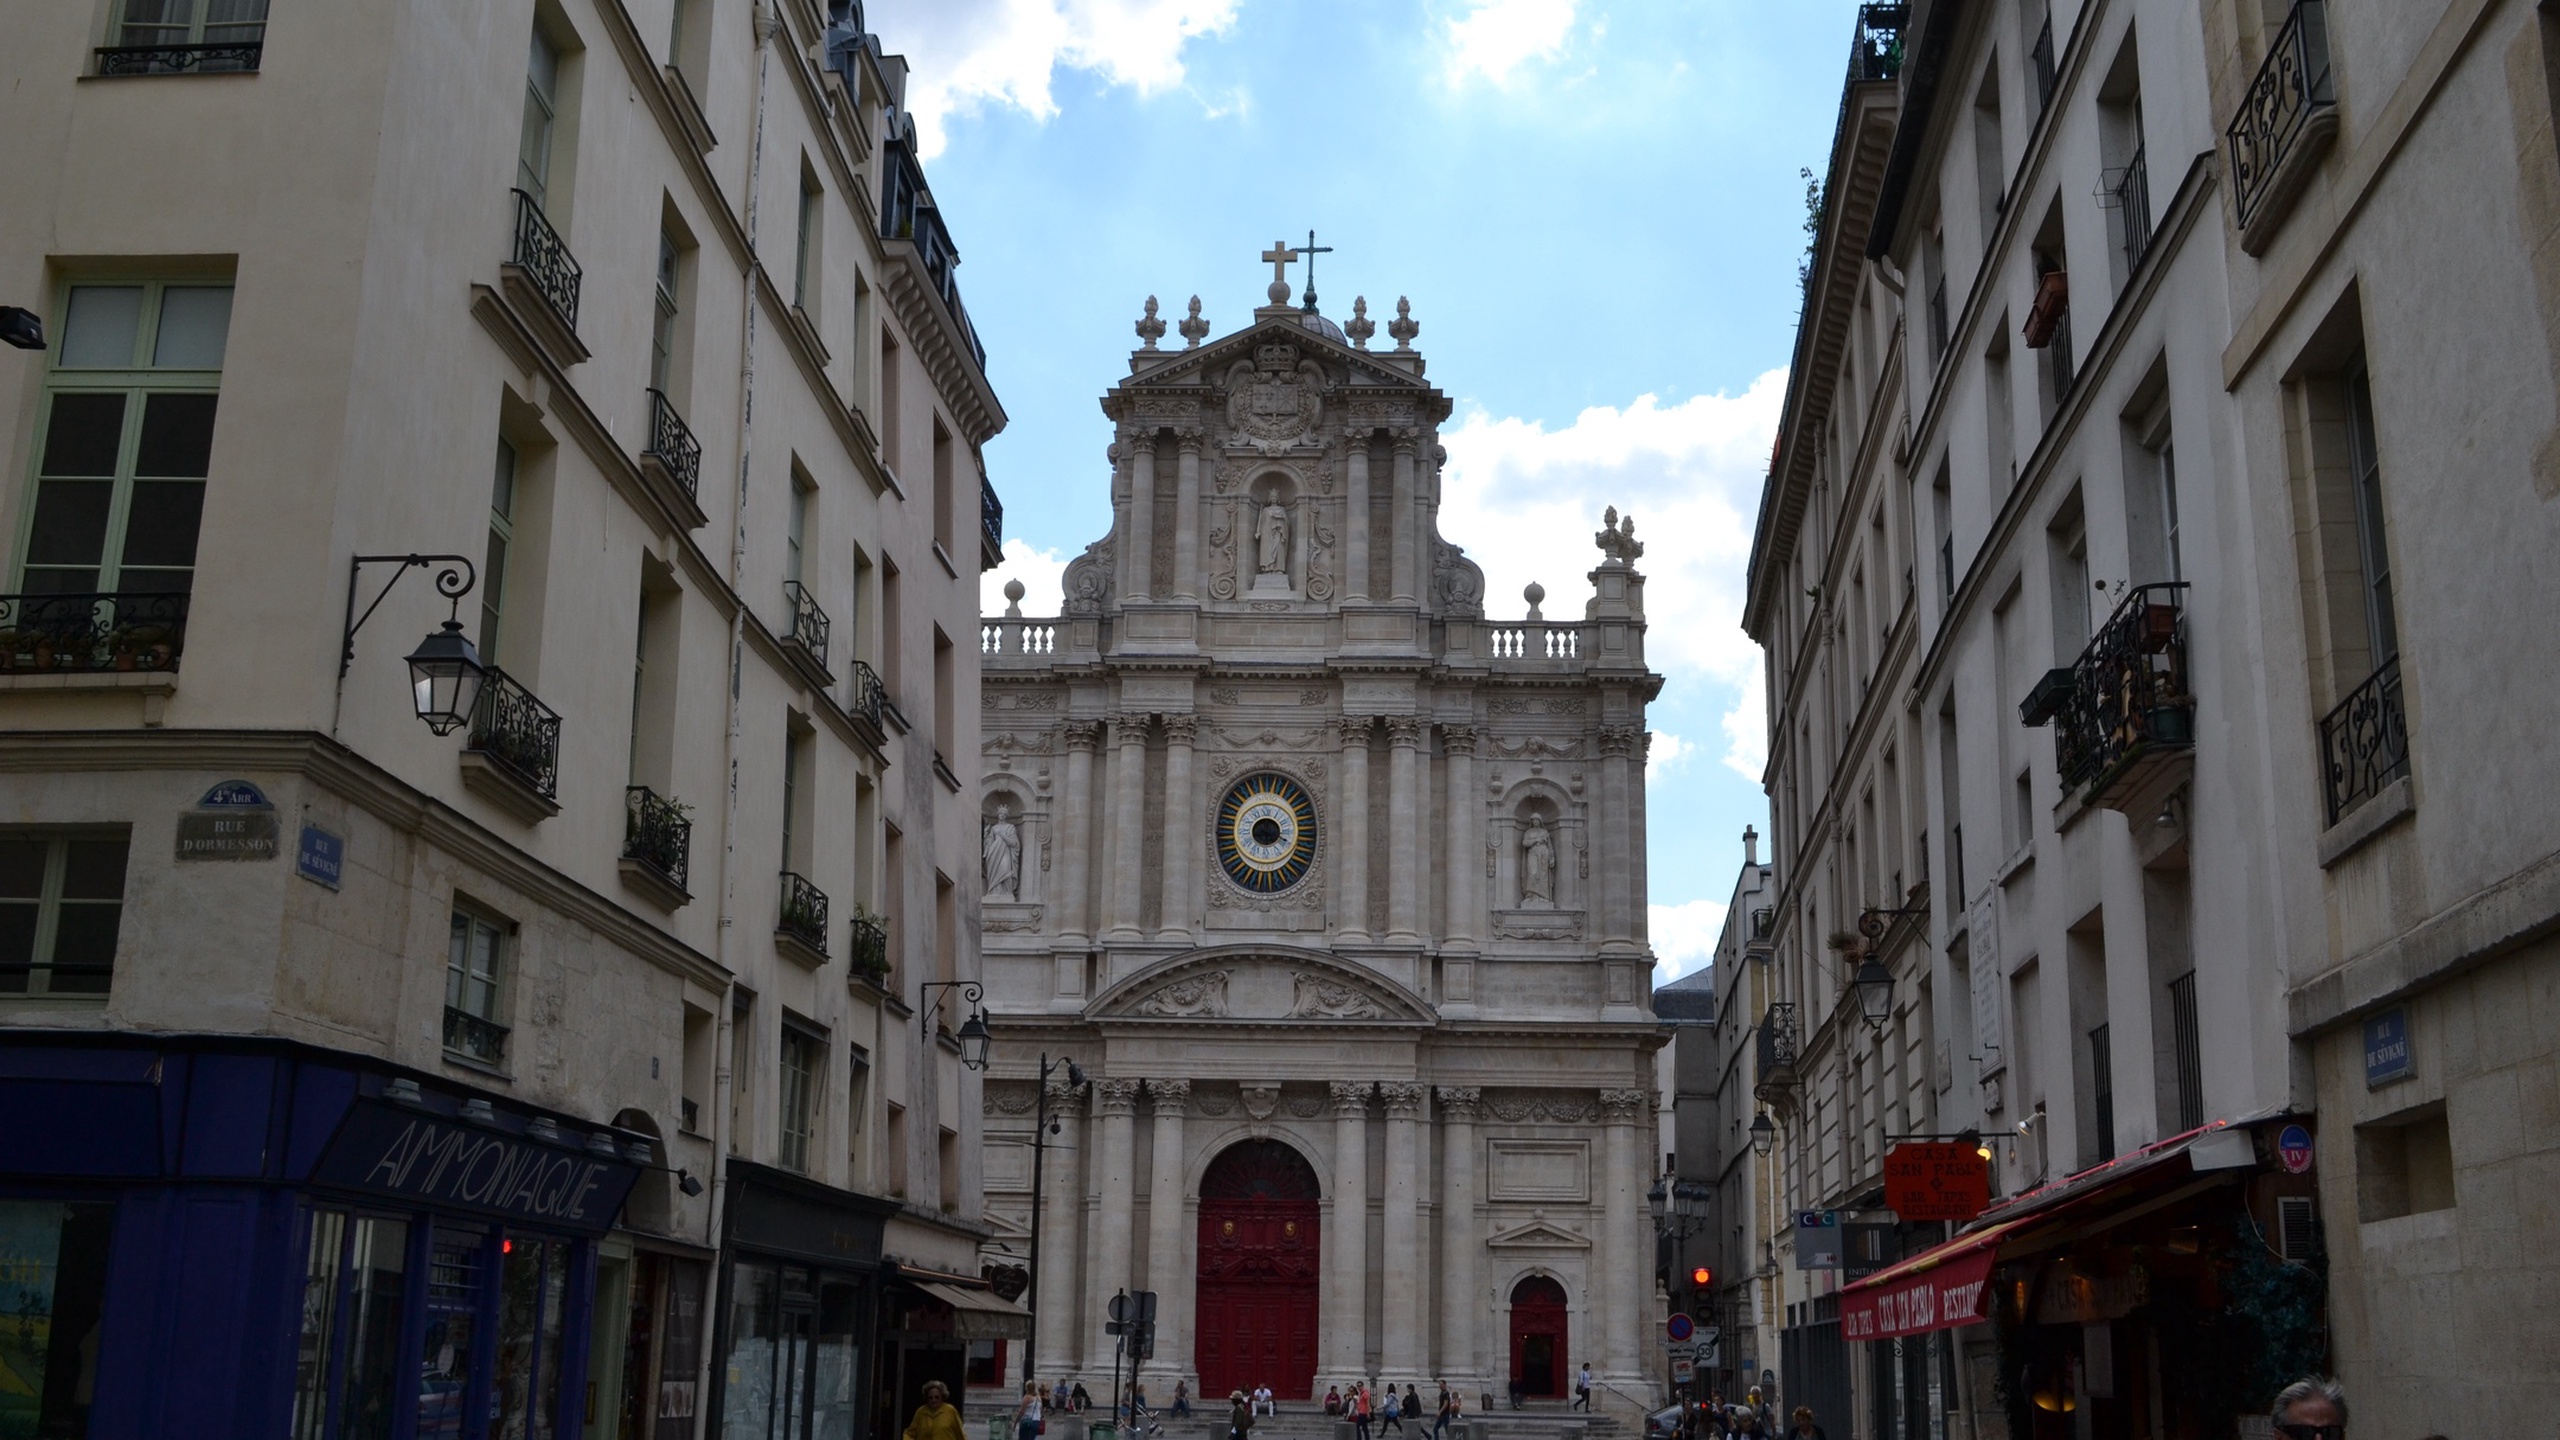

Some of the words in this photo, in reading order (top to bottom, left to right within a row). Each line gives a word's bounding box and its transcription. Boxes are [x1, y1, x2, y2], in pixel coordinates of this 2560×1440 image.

[214, 820, 246, 833] RUE
[183, 838, 275, 852] D'ORMESSON
[315, 838, 328, 855] RUE
[301, 851, 311, 865] DE
[312, 854, 339, 877] SÉVIGNÉ
[2377, 1022, 2391, 1040] RUE
[2367, 1051, 2376, 1068] DE
[2377, 1037, 2406, 1065] SÉVIGNÉ
[1911, 1147, 1958, 1160] CASA
[2291, 1150, 2303, 1161] IV
[364, 1119, 609, 1220] AMMONIAQUE
[1889, 1163, 1922, 1176] SAN
[1934, 1162, 1983, 1176] PABLO
[1902, 1191, 1925, 1203] BAR
[1937, 1191, 1972, 1203] TAPAS
[1903, 1204, 1971, 1216] RESTAURANT
[1803, 1213, 1832, 1226] CC
[1878, 1294, 1896, 1333] CASA
[1897, 1290, 1909, 1330] SAN
[1911, 1283, 1935, 1327] PABLO
[1699, 1347, 1711, 1356] 30
